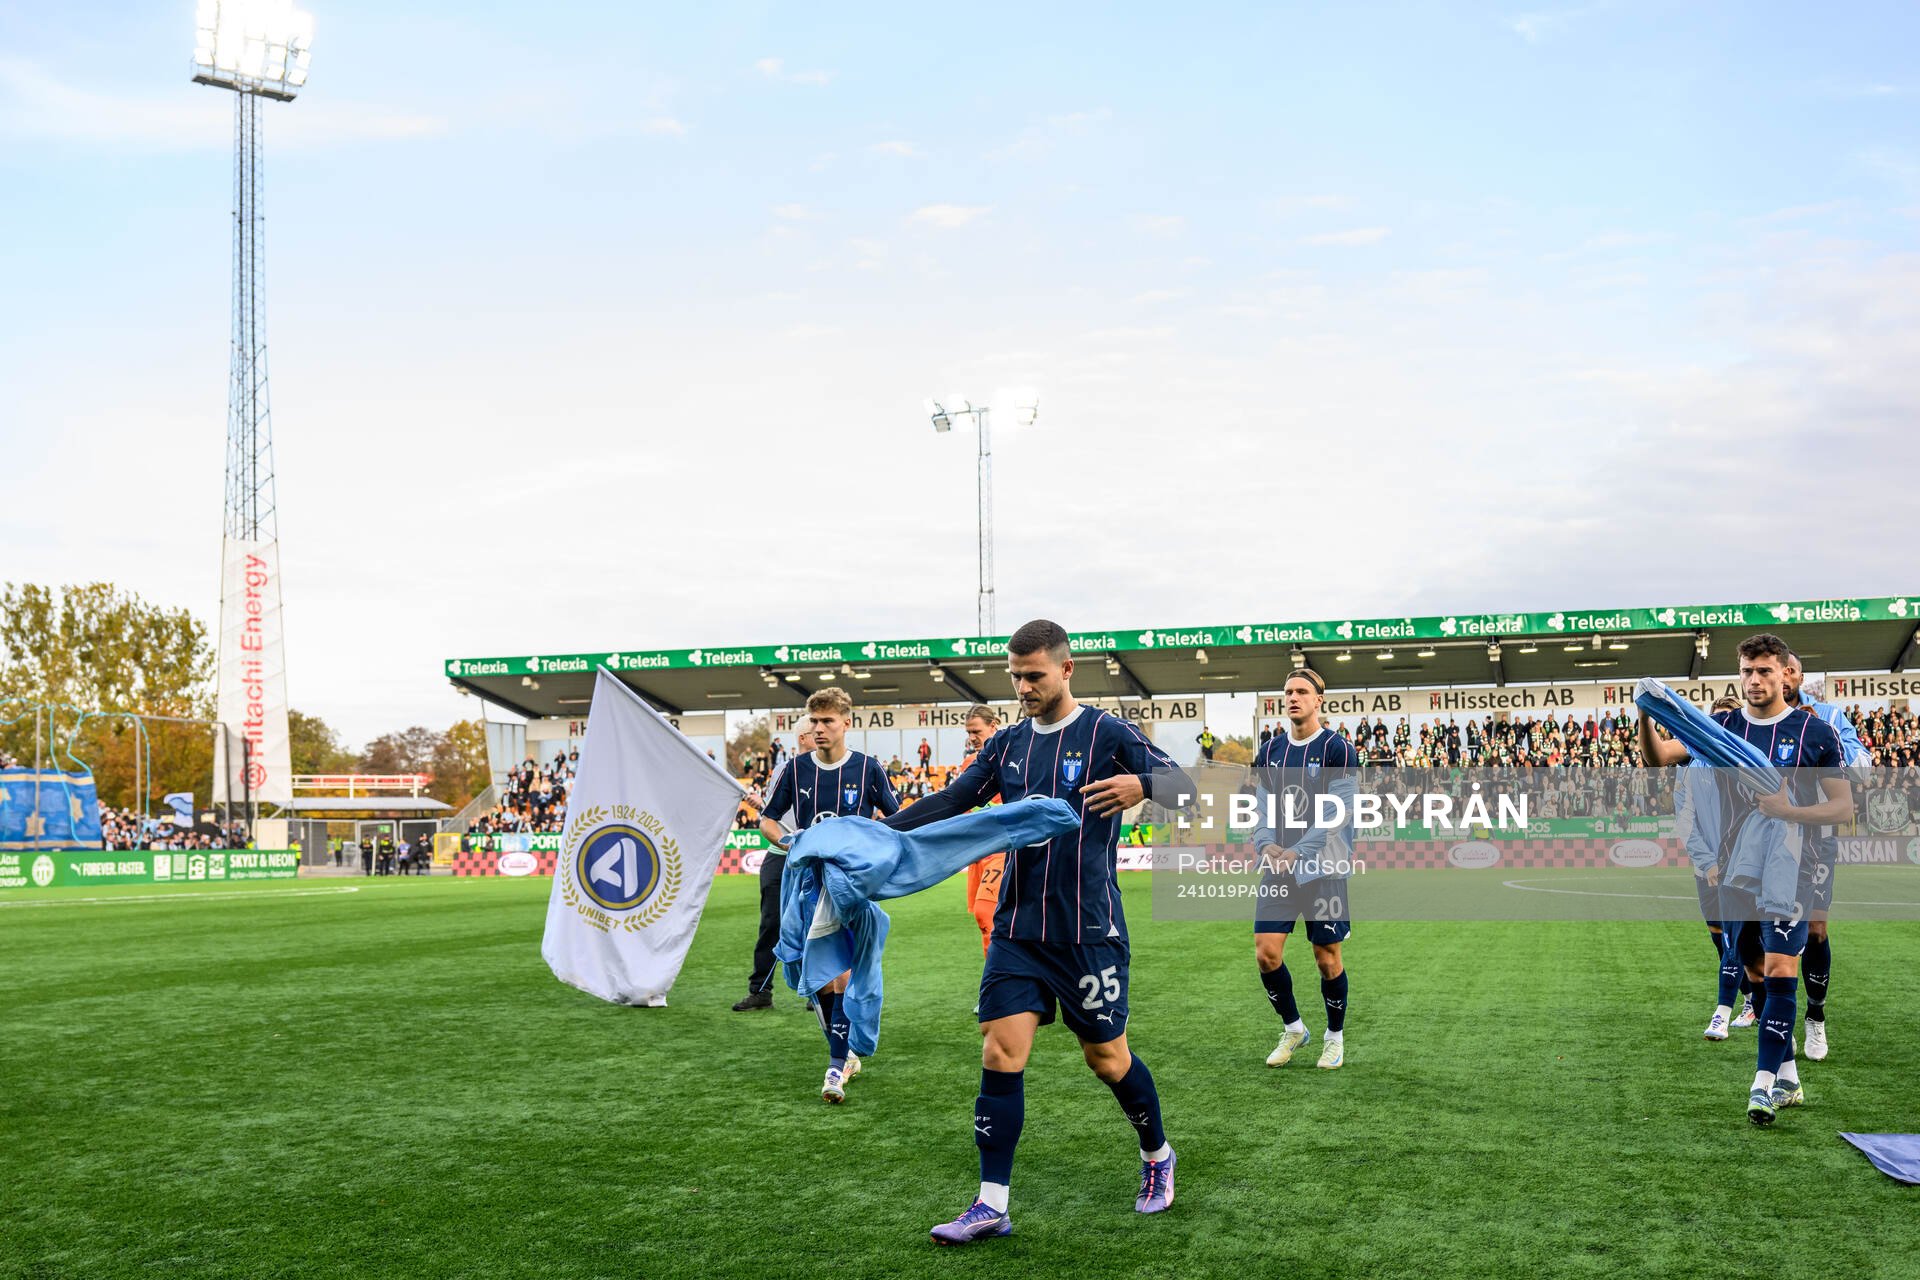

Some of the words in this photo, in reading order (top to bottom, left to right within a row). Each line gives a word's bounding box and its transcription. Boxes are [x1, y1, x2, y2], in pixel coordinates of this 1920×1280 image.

[241, 554, 268, 651] Energy
[1679, 609, 1745, 626] Telexia
[1793, 604, 1861, 621] Telexia
[1459, 618, 1522, 634] Telexia
[1567, 614, 1632, 630] Telexia
[1254, 627, 1313, 643] Telexia
[1355, 623, 1416, 638] Telexia
[968, 640, 1009, 654] Telex
[1069, 635, 1117, 650] elexia
[1156, 631, 1214, 647] Telexia
[704, 650, 754, 665] Telexia
[791, 646, 842, 661] Telexia
[877, 643, 931, 658] Telexia
[463, 661, 508, 675] Telexia
[541, 657, 588, 672] Telexia
[621, 654, 670, 668] Telexia
[1851, 677, 1920, 697] Hisste
[1372, 694, 1402, 712] AB
[1444, 689, 1535, 709] Hisstech
[1543, 688, 1575, 706] AB
[242, 661, 265, 757] Hitachi
[1169, 702, 1197, 719] AB
[869, 712, 894, 728] AB
[611, 805, 665, 836] 1924-2024
[724, 832, 761, 849] Apta
[1837, 840, 1898, 862] NSKAN
[268, 853, 296, 867] NEON
[981, 869, 1002, 883] 27
[1314, 895, 1343, 921] 20
[578, 904, 621, 929] UNIBET
[1078, 965, 1121, 1010] 25
